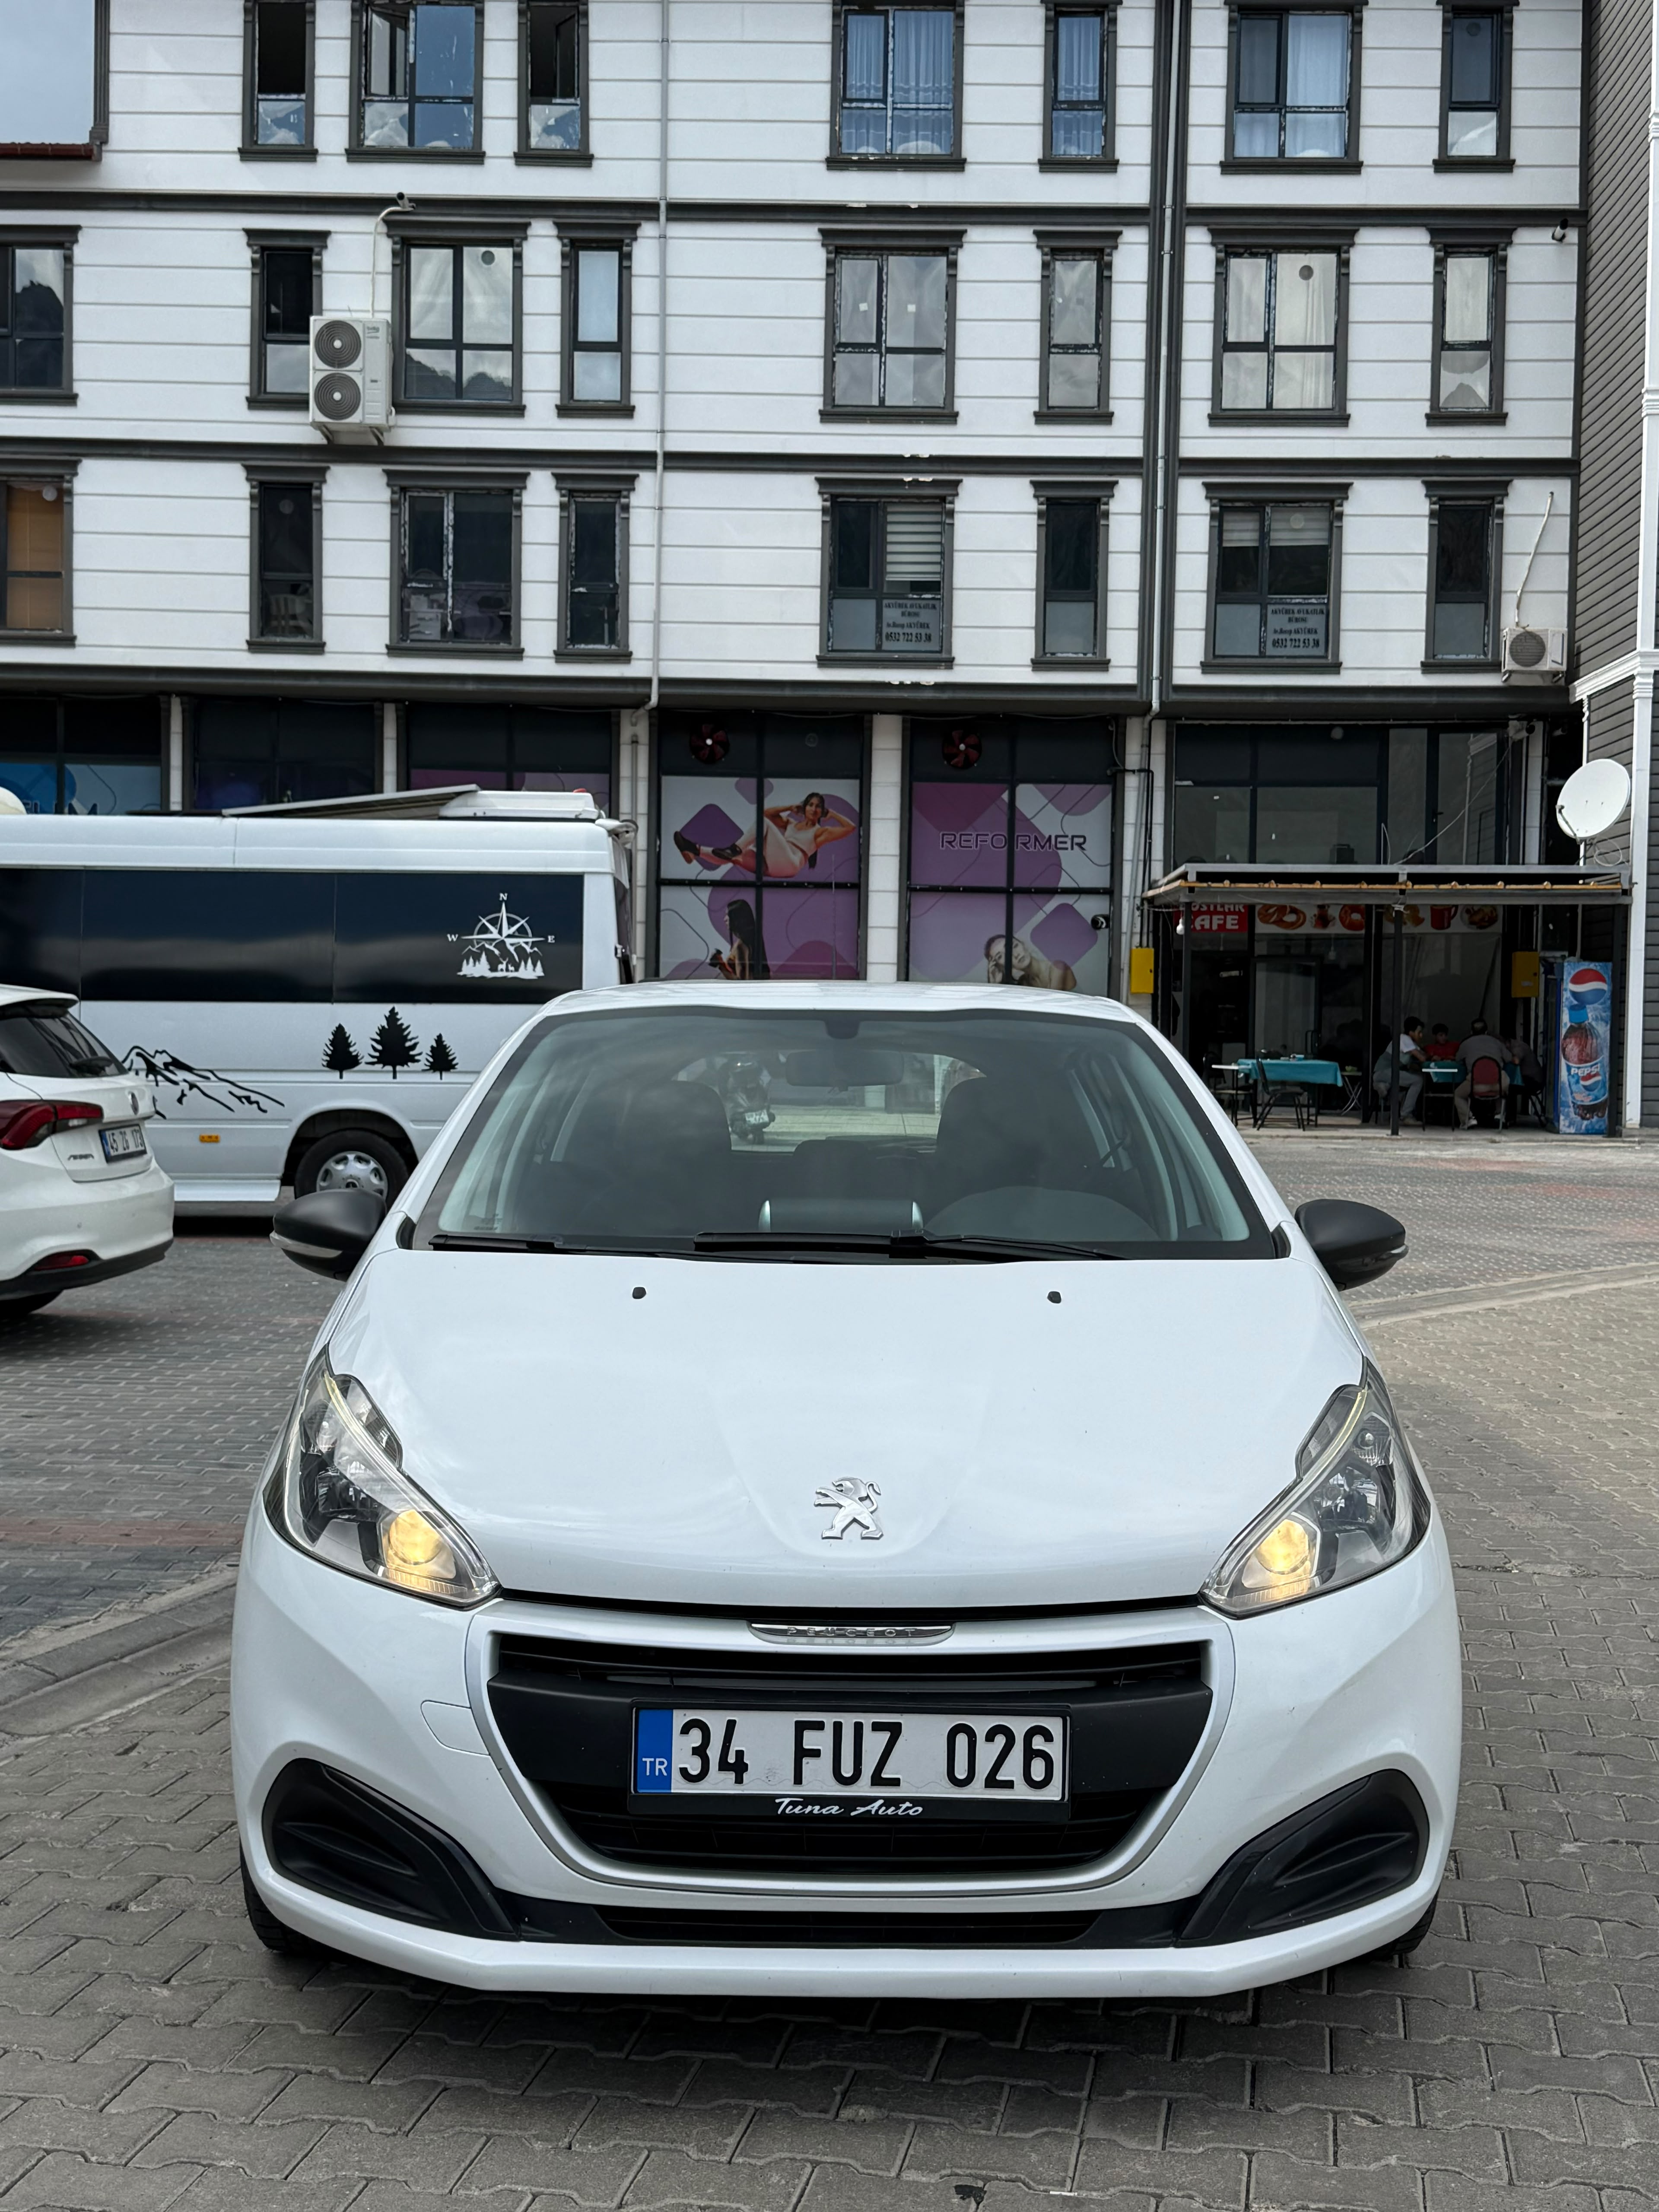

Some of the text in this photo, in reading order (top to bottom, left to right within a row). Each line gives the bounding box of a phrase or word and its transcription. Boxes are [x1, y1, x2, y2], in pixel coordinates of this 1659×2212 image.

[885, 632, 900, 642] 0532
[902, 632, 913, 642] 722
[915, 632, 922, 642] 53
[1272, 638, 1320, 648] 0532 722 53 38
[940, 832, 1087, 852] REFORMER
[1191, 902, 1245, 912] OSTLAR
[1191, 915, 1239, 931] AFE
[447, 934, 458, 942] W
[787, 1626, 916, 1637] PEUGEOT
[679, 1718, 1054, 1790] 34 FUZ 026
[642, 1758, 667, 1776] TR
[775, 1798, 923, 1816] Tuna Auto
